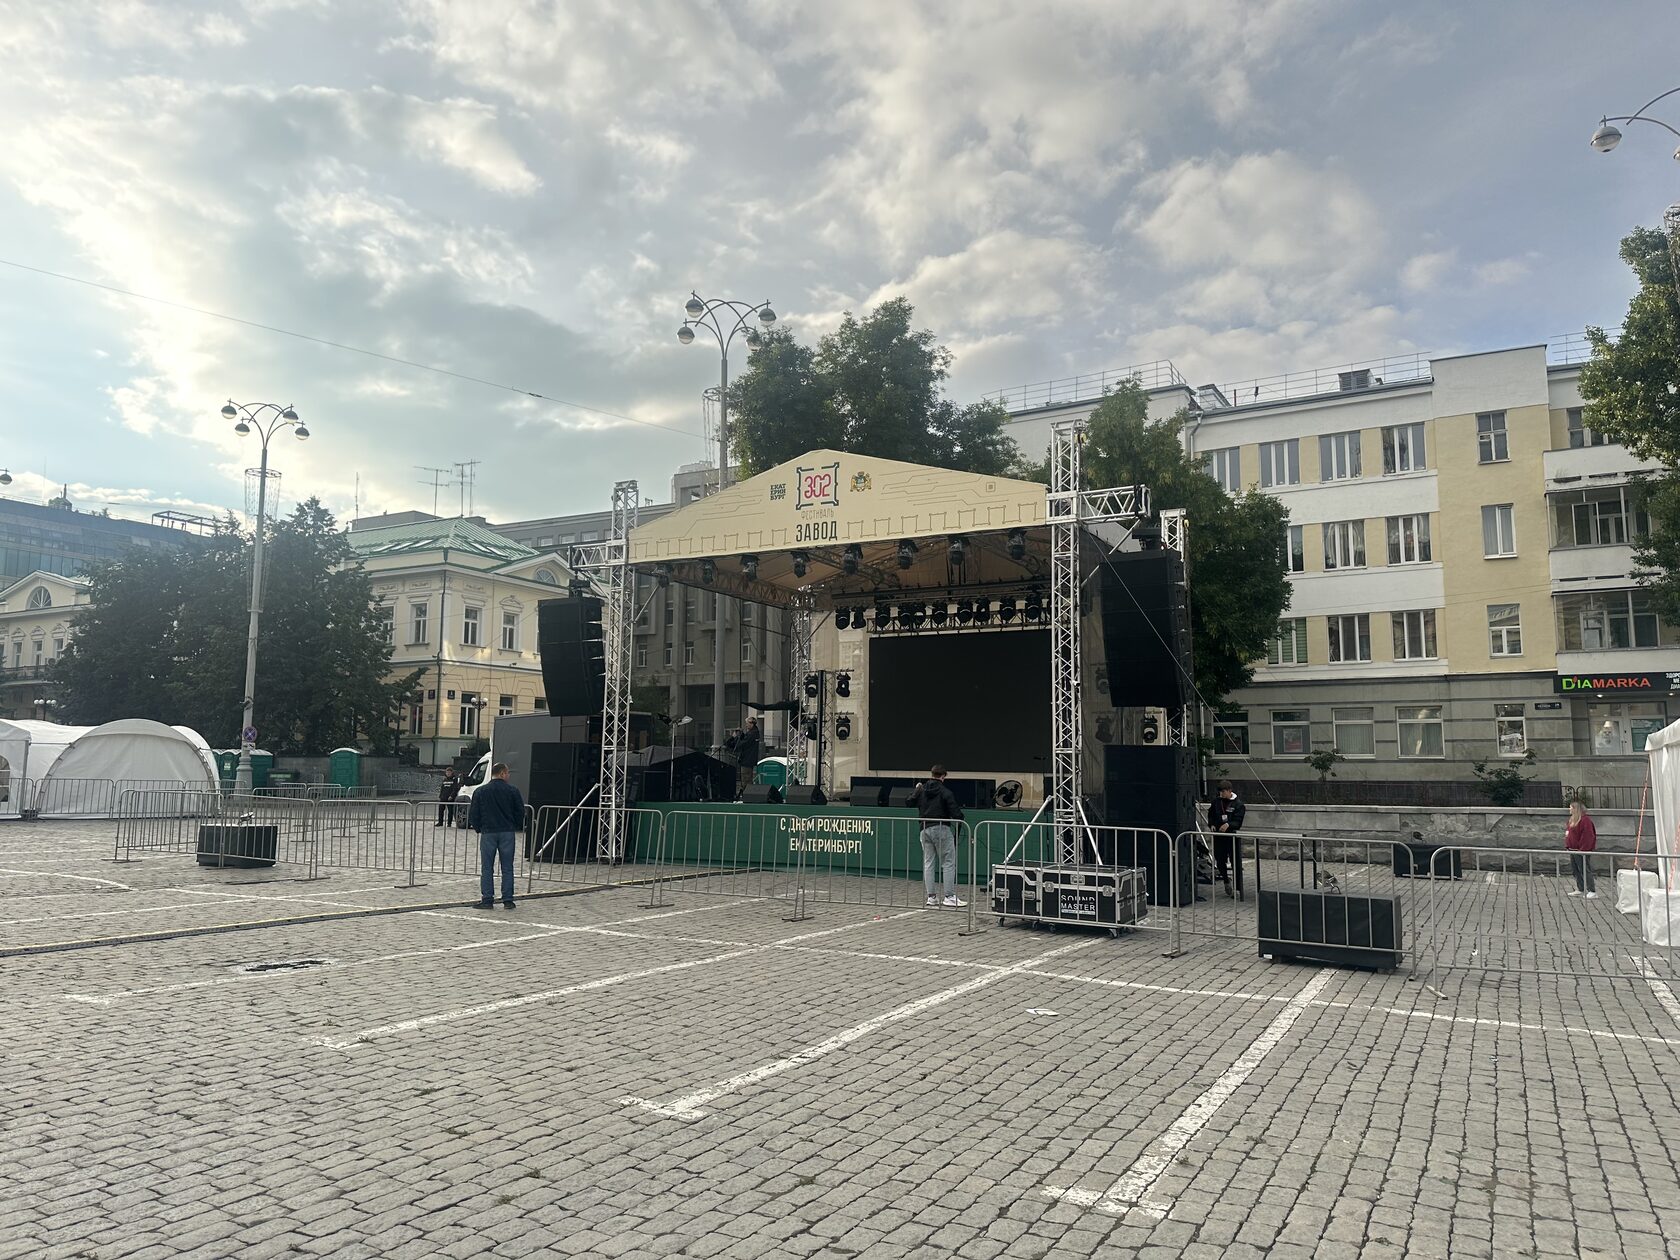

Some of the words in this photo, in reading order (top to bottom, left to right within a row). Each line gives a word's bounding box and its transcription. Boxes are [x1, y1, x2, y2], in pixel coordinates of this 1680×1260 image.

[804, 474, 831, 499] 302
[801, 509, 835, 520] ФЕСТИВАЛЬ
[796, 521, 837, 541] ЗАВОД
[780, 817, 786, 830] С
[788, 818, 815, 833] ДНЕМ
[817, 819, 874, 836] РОЖДЕНИЯ,
[1060, 902, 1095, 911] MASTER
